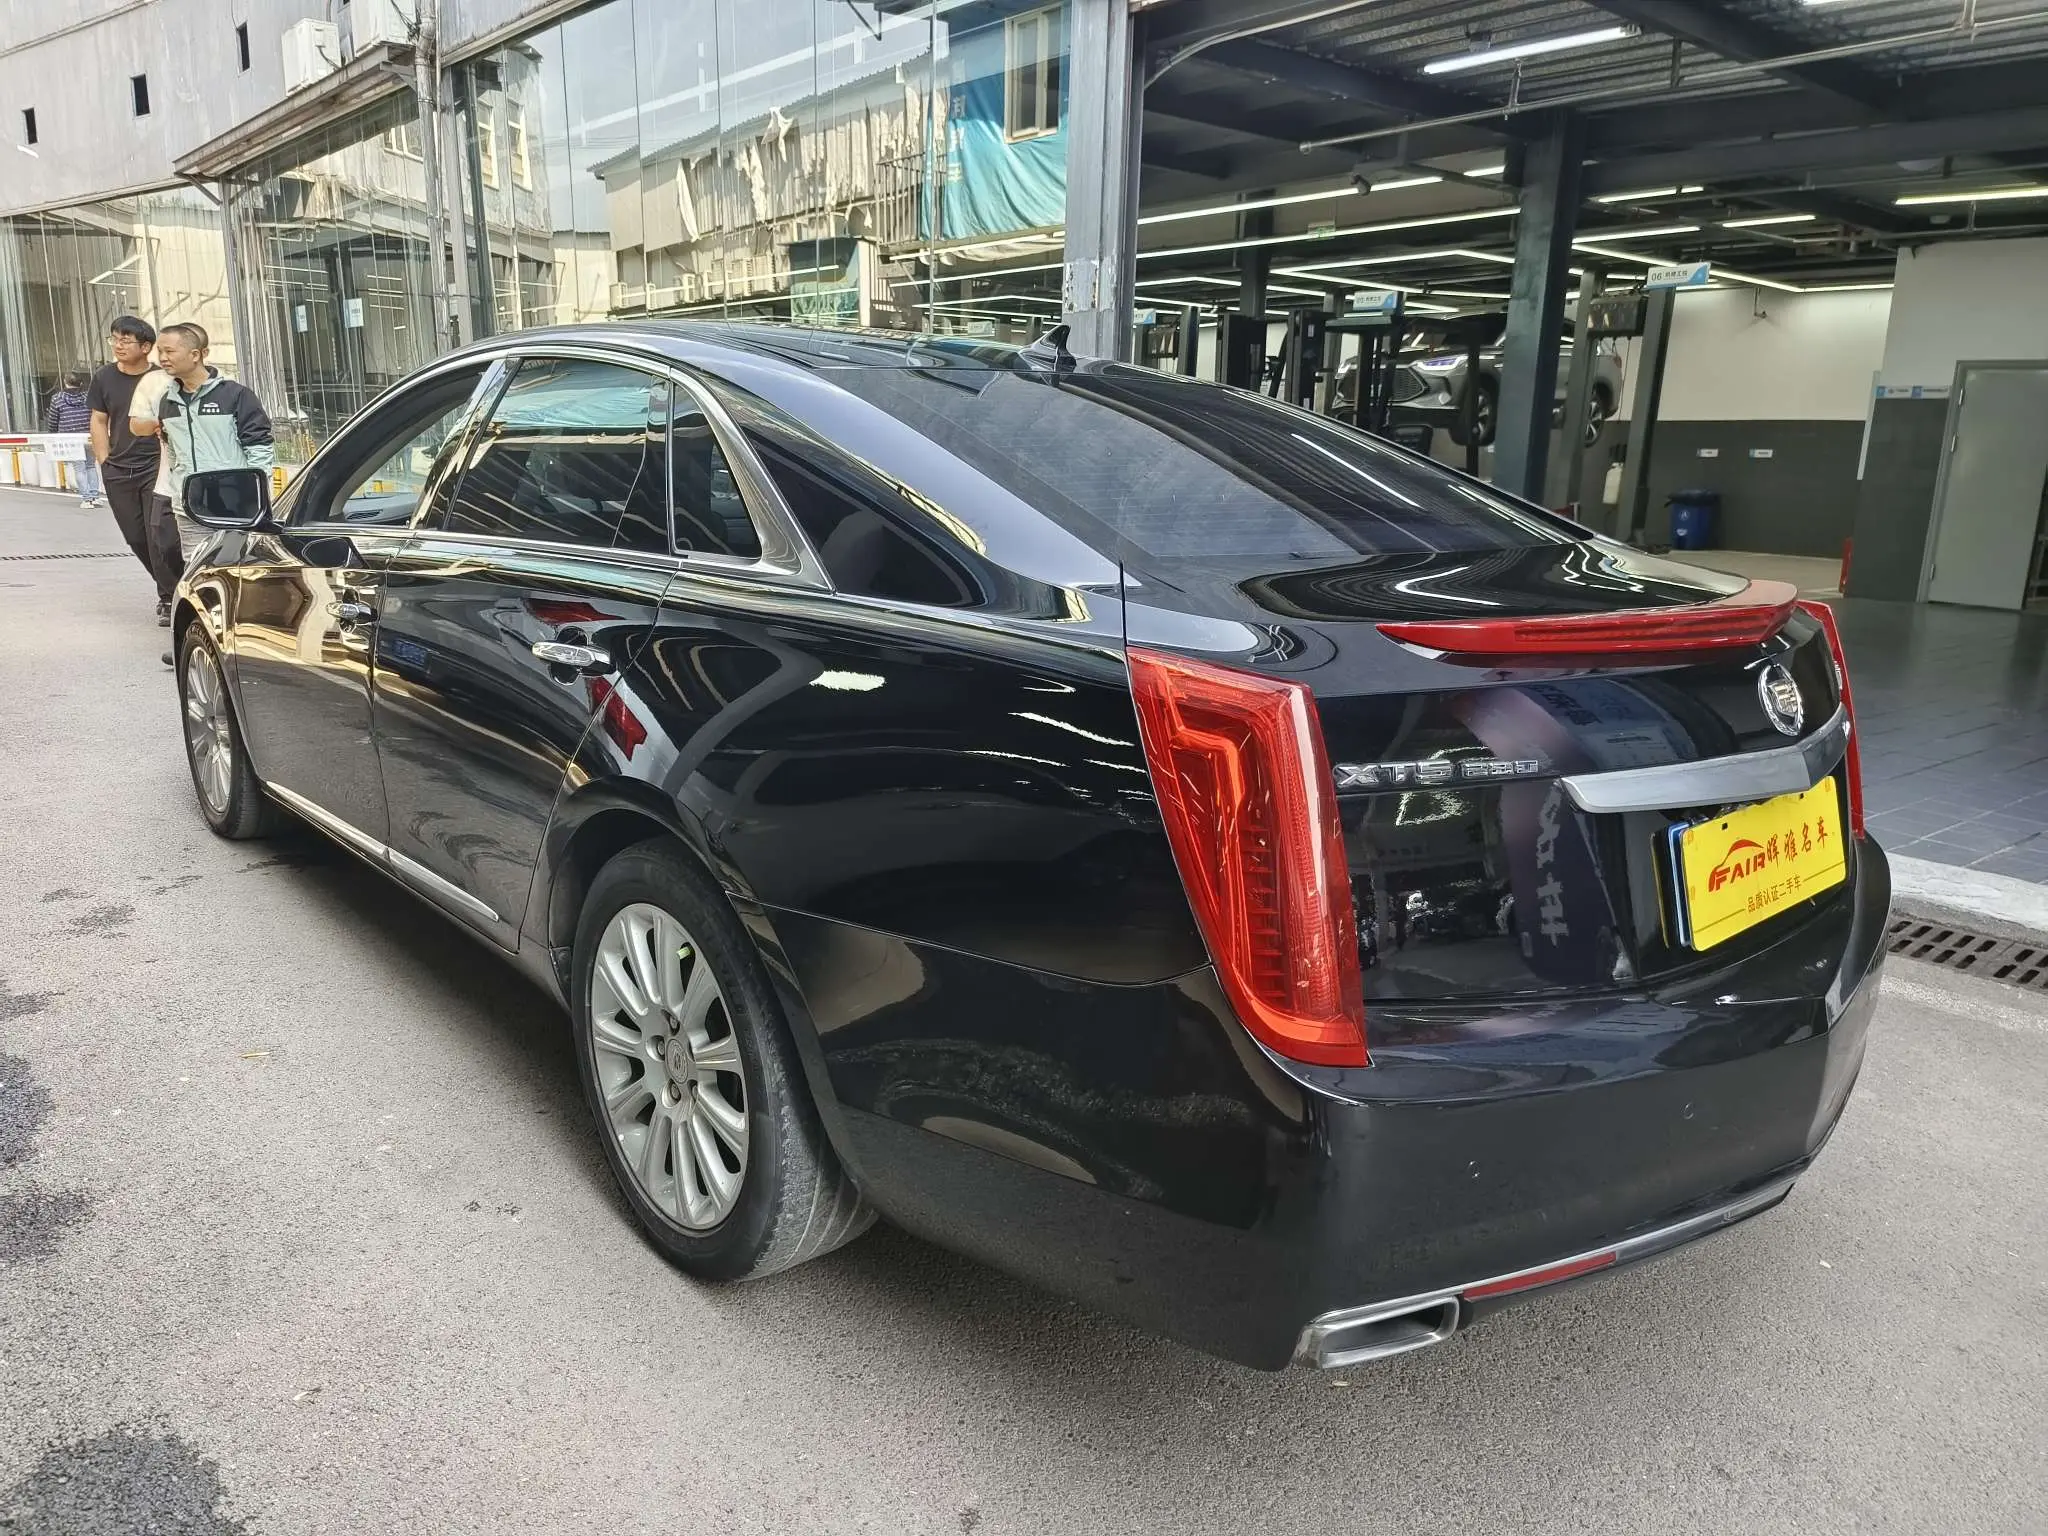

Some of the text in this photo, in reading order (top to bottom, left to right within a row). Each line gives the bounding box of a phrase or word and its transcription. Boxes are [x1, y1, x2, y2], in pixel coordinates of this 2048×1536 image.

[1651, 272, 1662, 281] 06
[1335, 759, 1451, 787] XTS
[1708, 851, 1766, 893] FAIR
[1747, 874, 1801, 913] 品质认证二手车
